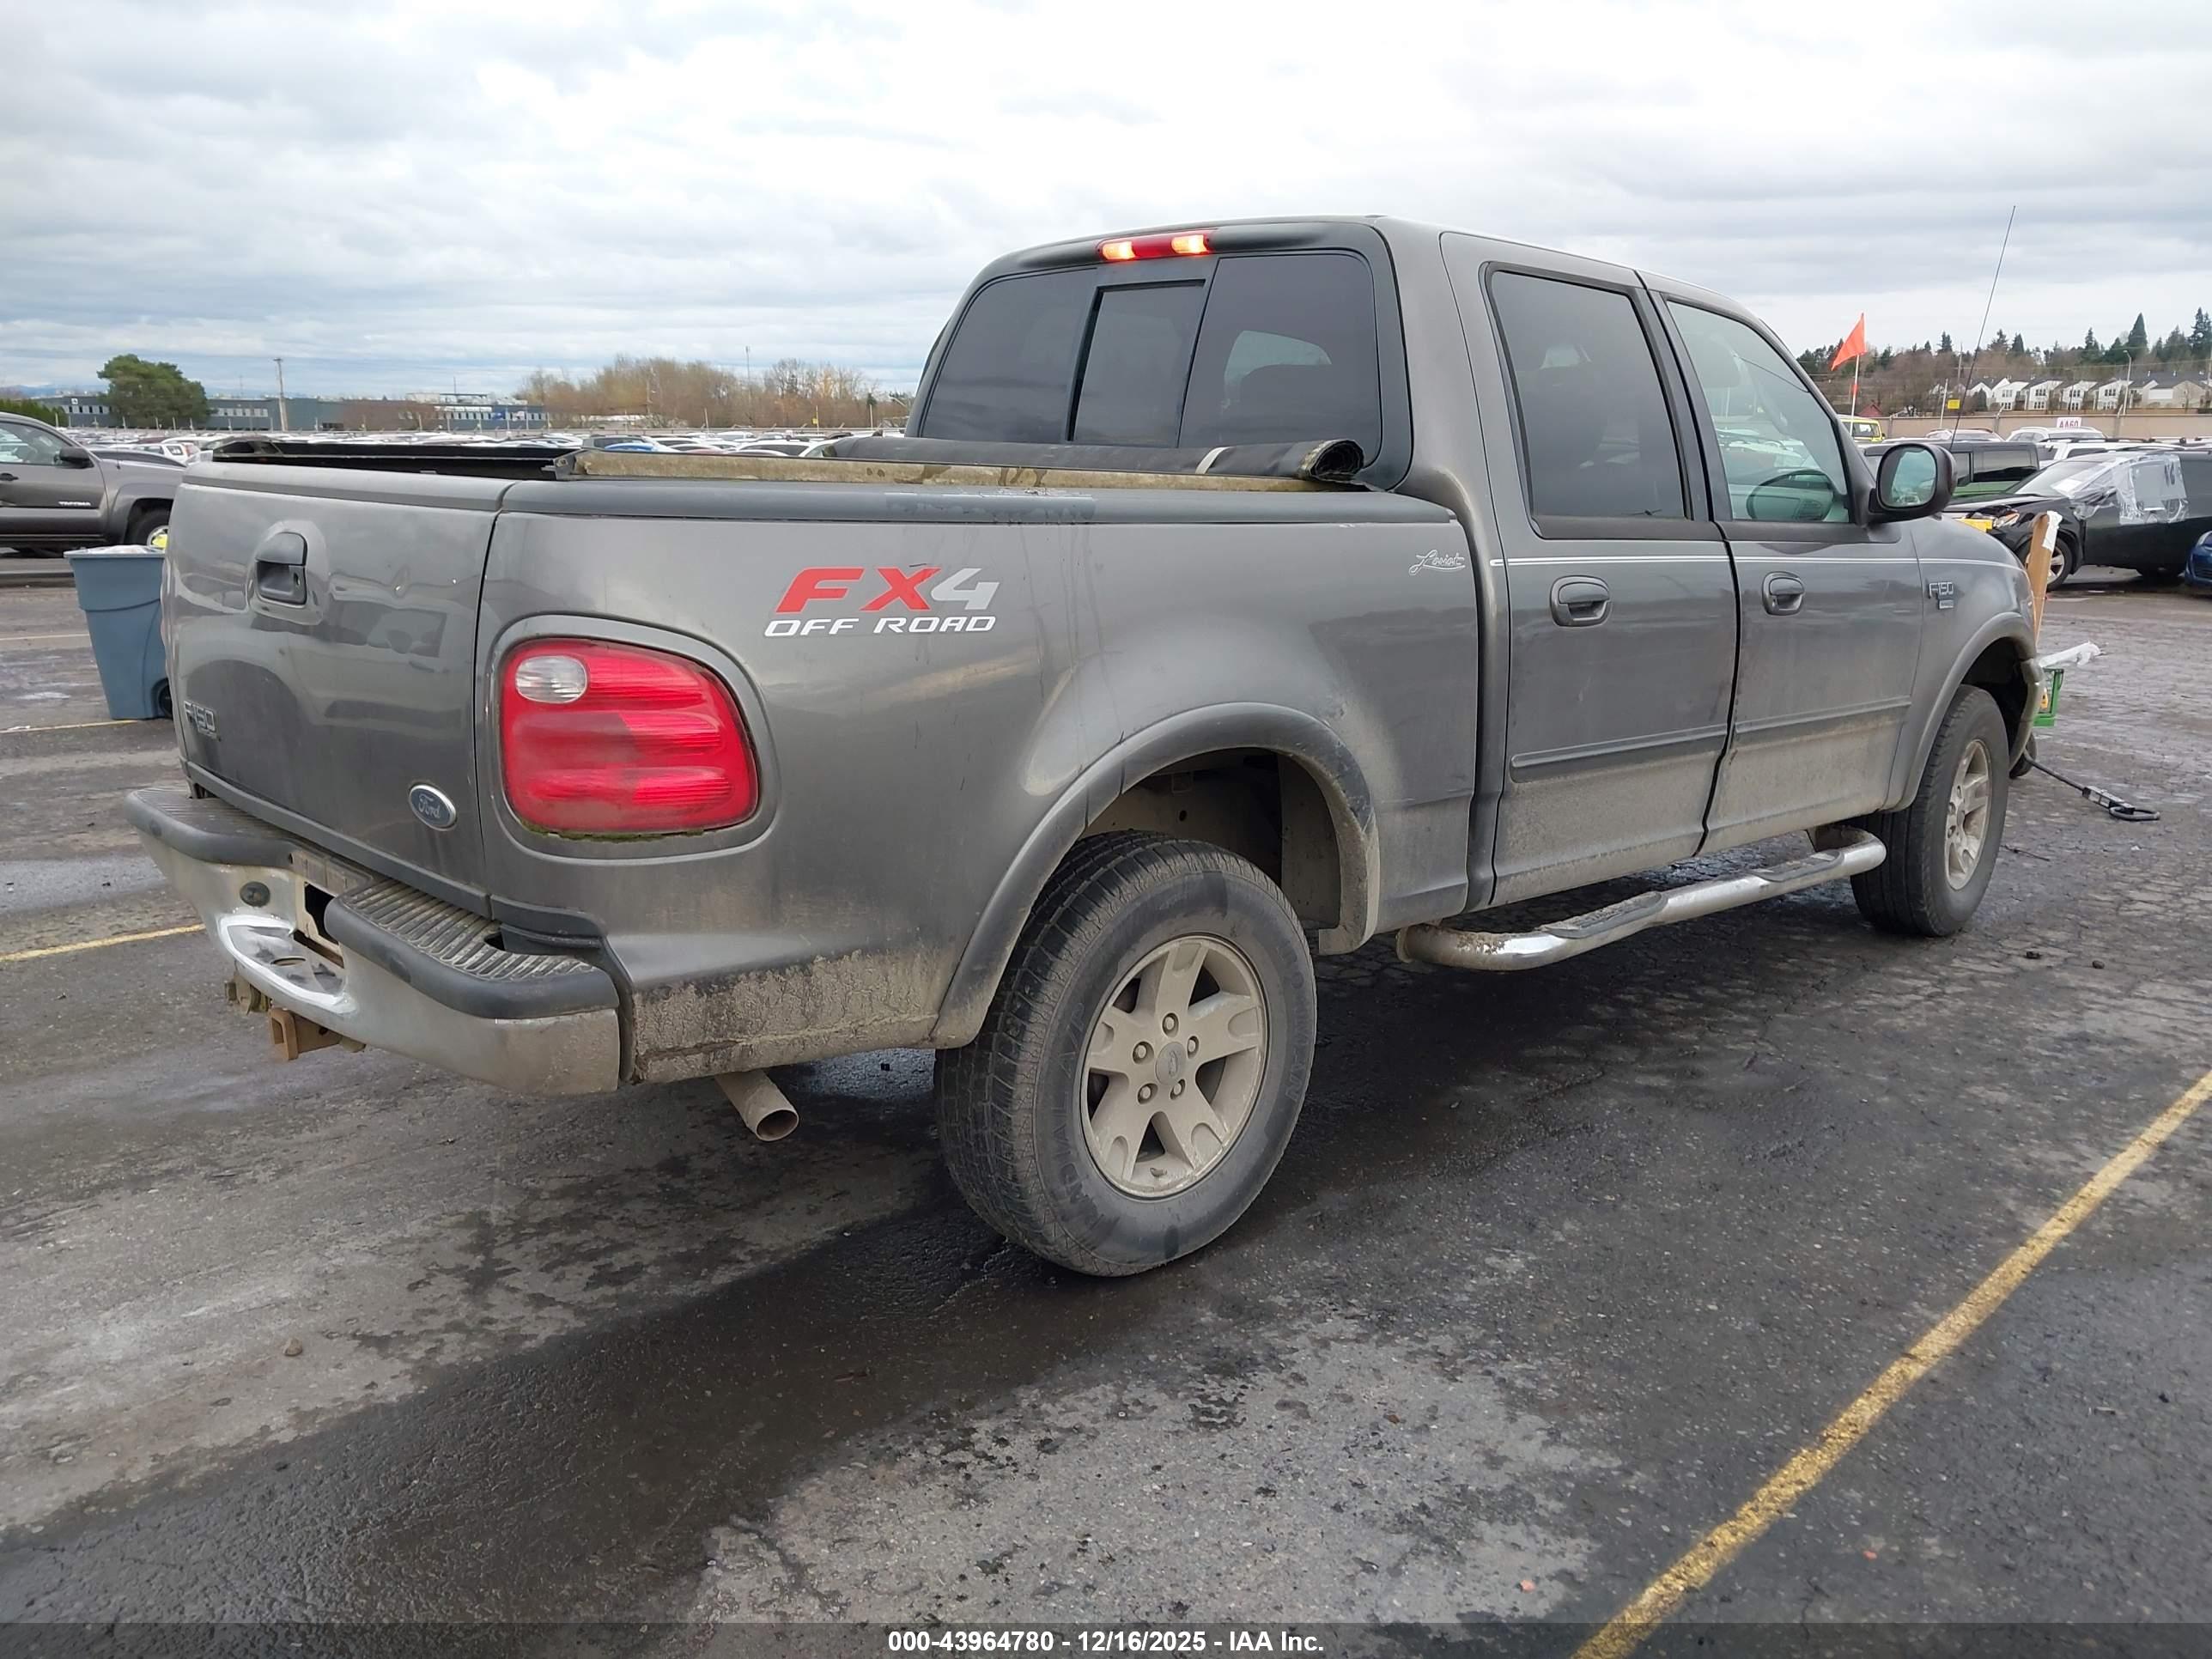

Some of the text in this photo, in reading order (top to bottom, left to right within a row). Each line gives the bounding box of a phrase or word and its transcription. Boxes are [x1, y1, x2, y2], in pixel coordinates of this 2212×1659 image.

[775, 567, 1000, 613] FX4
[764, 616, 996, 636] OFF ROAD
[418, 793, 441, 819] Ford
